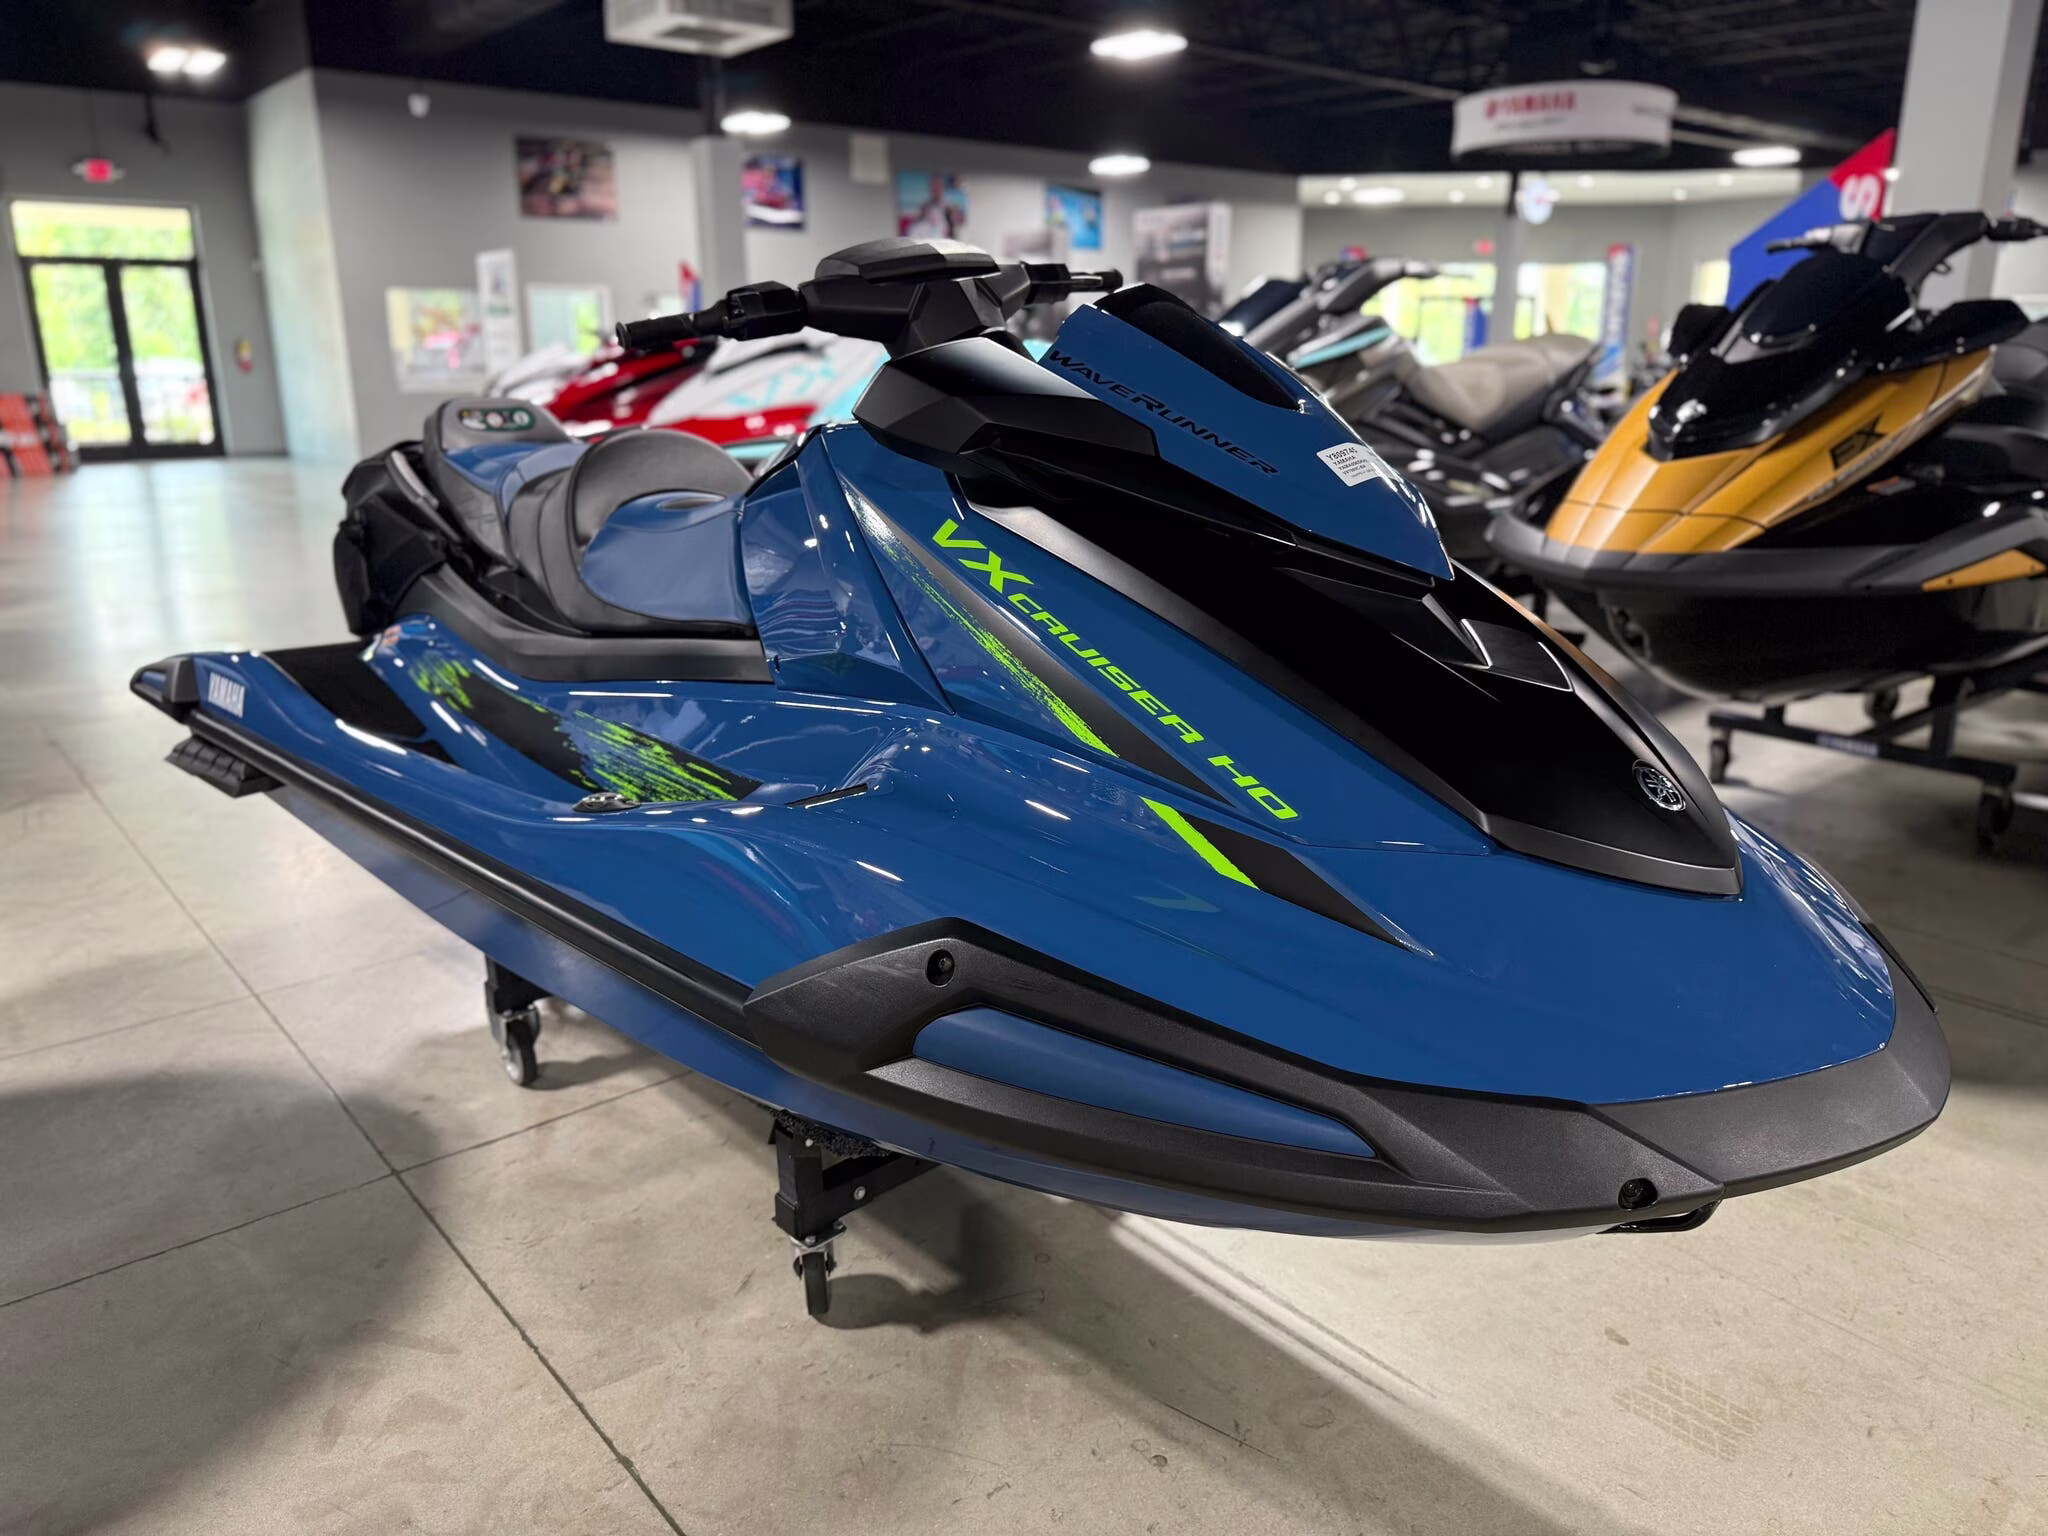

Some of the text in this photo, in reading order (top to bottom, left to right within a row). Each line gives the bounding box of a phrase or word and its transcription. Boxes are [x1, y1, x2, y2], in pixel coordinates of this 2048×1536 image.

[1048, 350, 1280, 475] WAVERUNNER
[1829, 411, 1887, 470] EX
[208, 671, 246, 719] YAMAHA
[932, 518, 1299, 820] VX CRUISER HO
